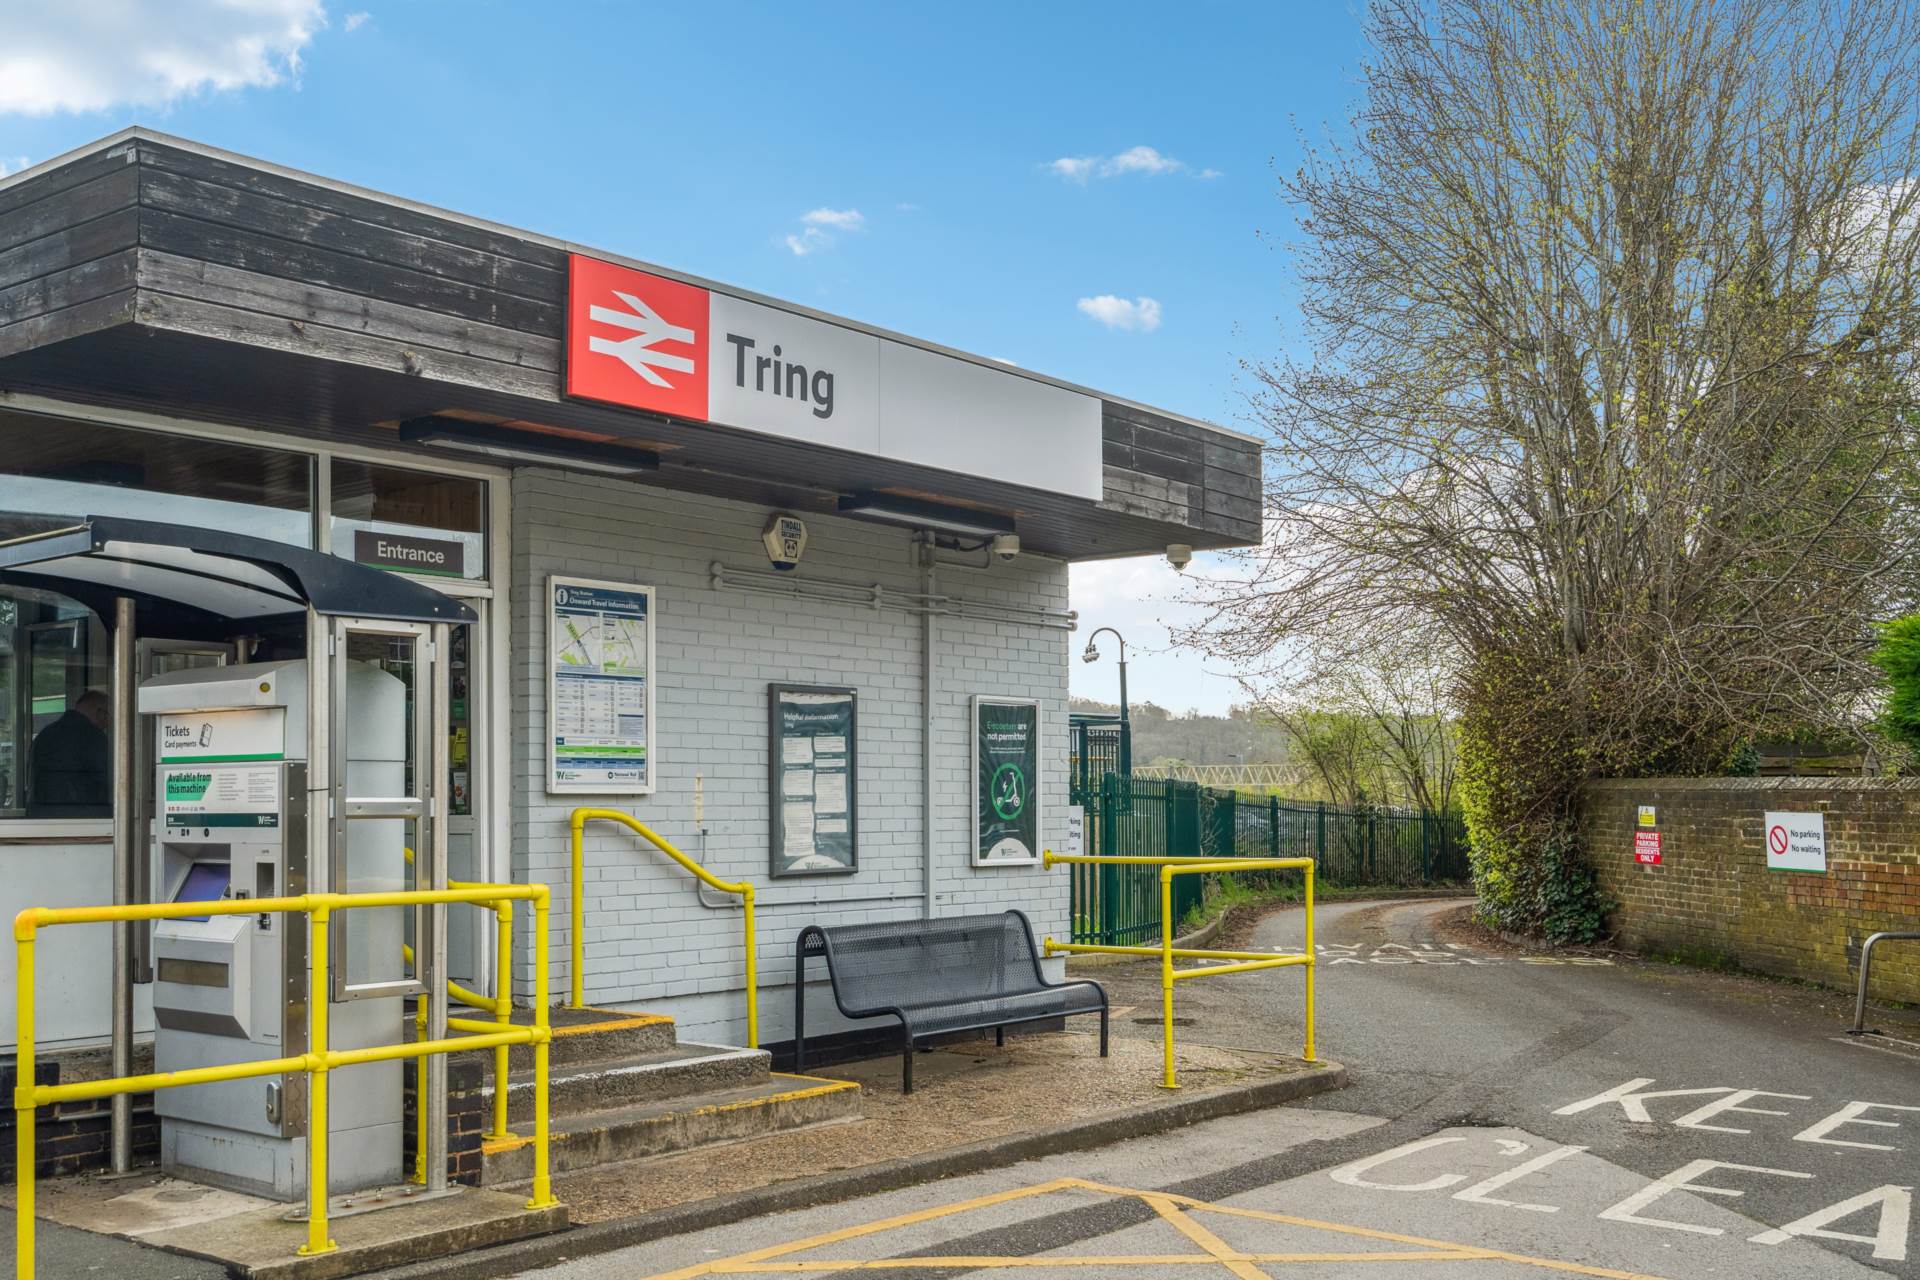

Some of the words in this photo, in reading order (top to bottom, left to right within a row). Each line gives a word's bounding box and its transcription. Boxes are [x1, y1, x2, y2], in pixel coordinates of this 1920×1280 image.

[726, 332, 834, 419] Tring
[377, 541, 445, 564] Entrance
[569, 598, 592, 606] Onward
[592, 599, 608, 607] Travel
[783, 712, 804, 721] Helpful
[165, 726, 190, 737] Tickets
[998, 732, 1027, 742] permitted
[175, 740, 197, 749] payments
[168, 773, 195, 783] Available
[196, 772, 212, 782] from
[168, 784, 180, 794] this
[180, 784, 206, 794] machine
[1070, 816, 1081, 827] king
[1636, 832, 1659, 840] PRIVATE
[1791, 830, 1799, 838] No
[1800, 830, 1821, 840] parking
[1636, 840, 1659, 848] PARKING
[1792, 844, 1800, 852] No
[1801, 845, 1822, 855] waiting
[1640, 854, 1655, 863] ONLY
